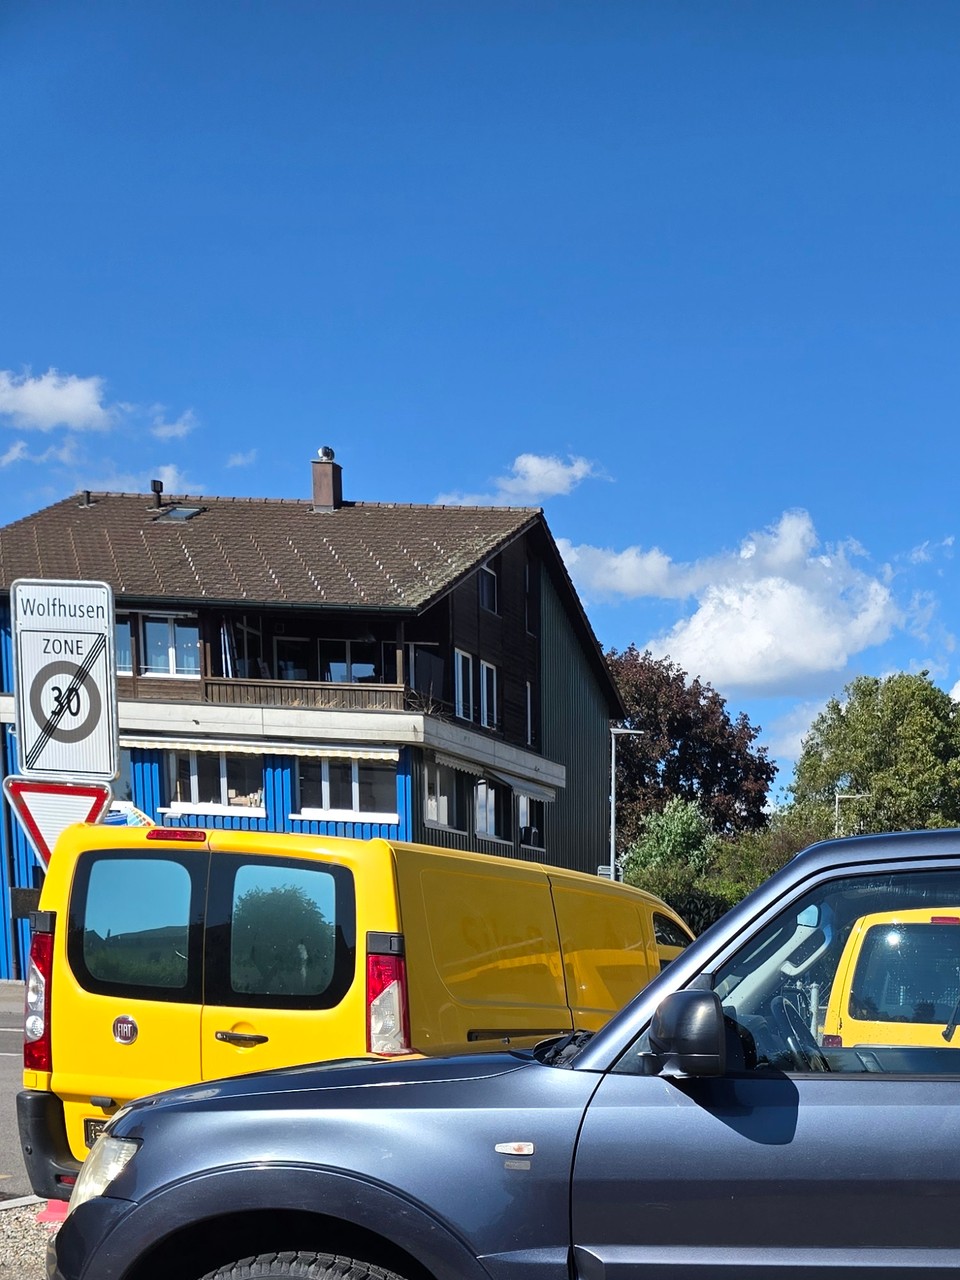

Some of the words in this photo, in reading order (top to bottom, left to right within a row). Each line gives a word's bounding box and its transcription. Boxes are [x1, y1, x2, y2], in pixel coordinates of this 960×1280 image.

[21, 597, 105, 619] Wolfhusen
[43, 638, 84, 655] ZONE
[51, 686, 81, 716] 30
[117, 1023, 133, 1037] FIAT
